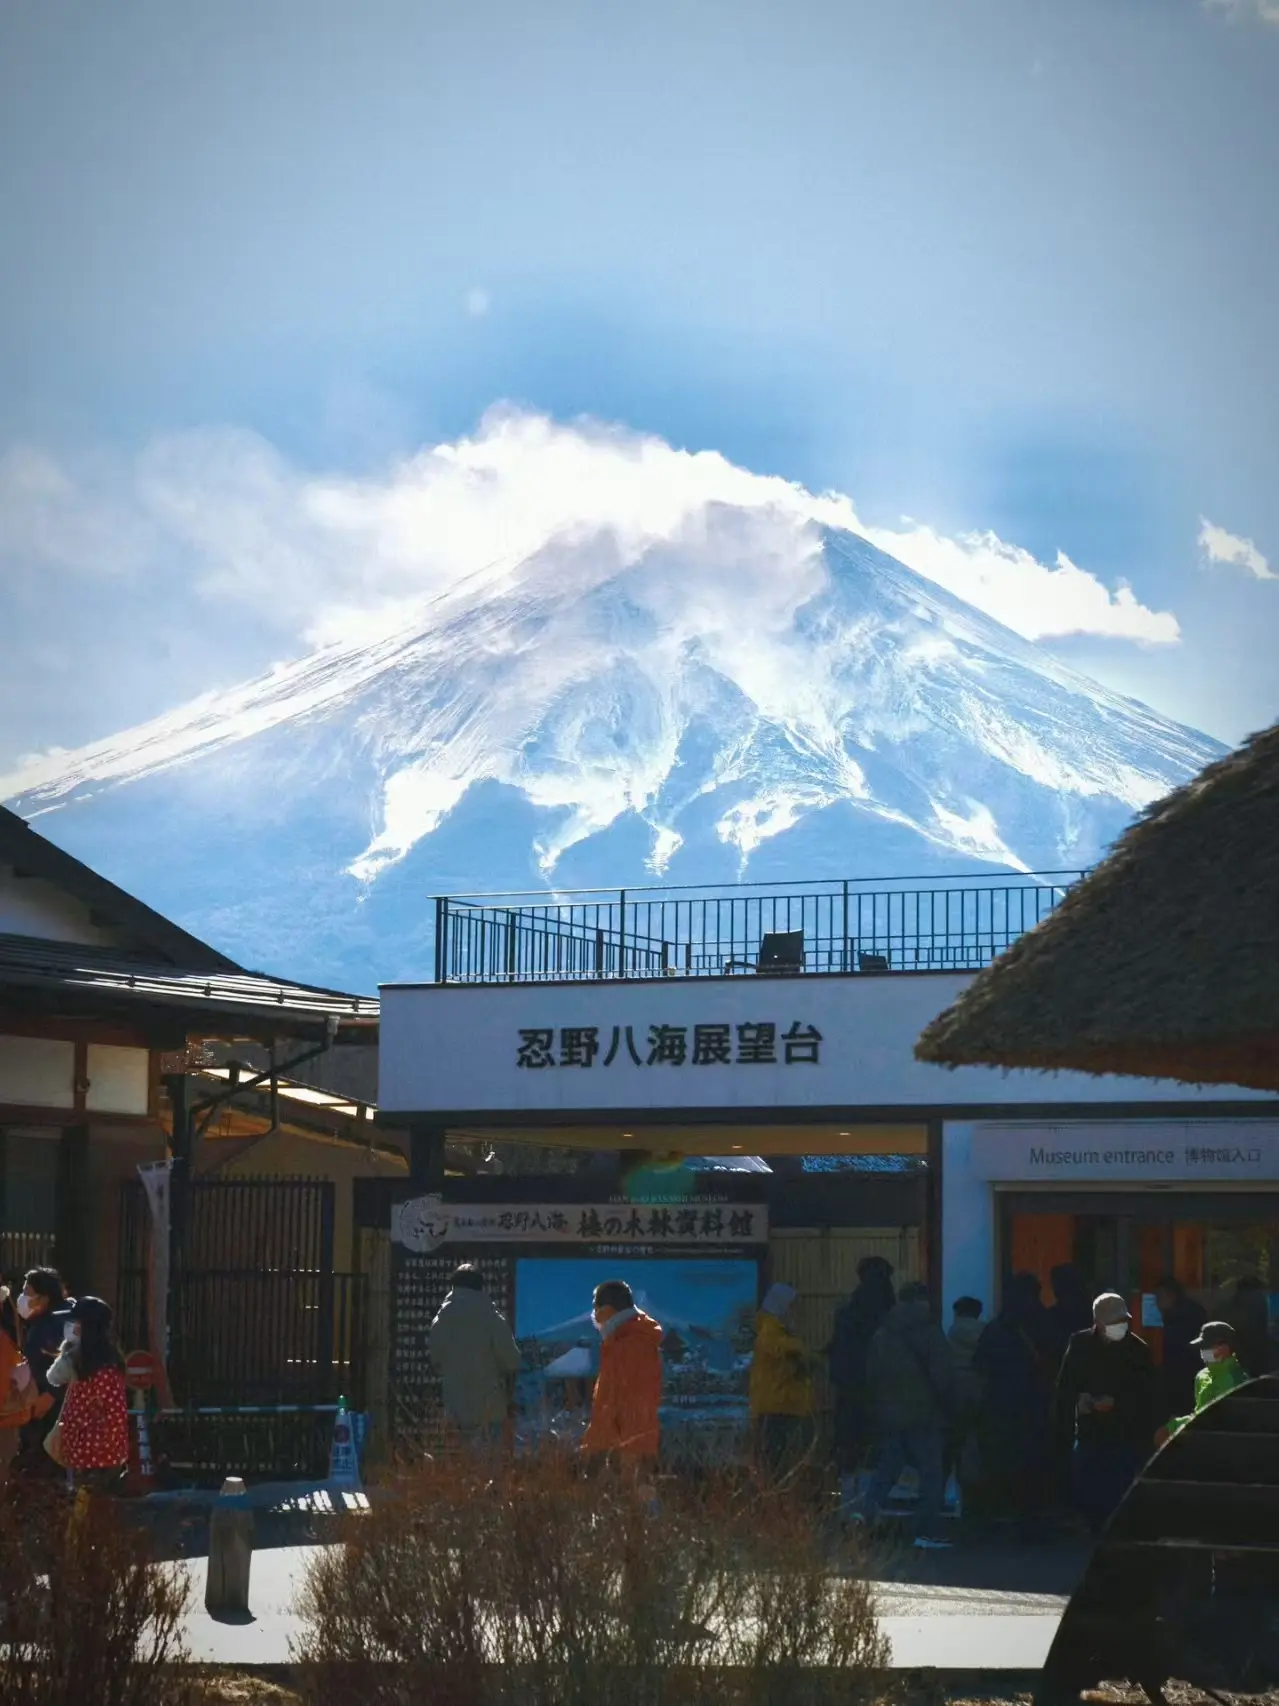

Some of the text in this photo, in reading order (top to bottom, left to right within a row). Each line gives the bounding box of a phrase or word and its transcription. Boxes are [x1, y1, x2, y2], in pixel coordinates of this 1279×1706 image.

[516, 1021, 824, 1069] 忍野八海展望台
[1029, 1147, 1175, 1165] Museum entrance
